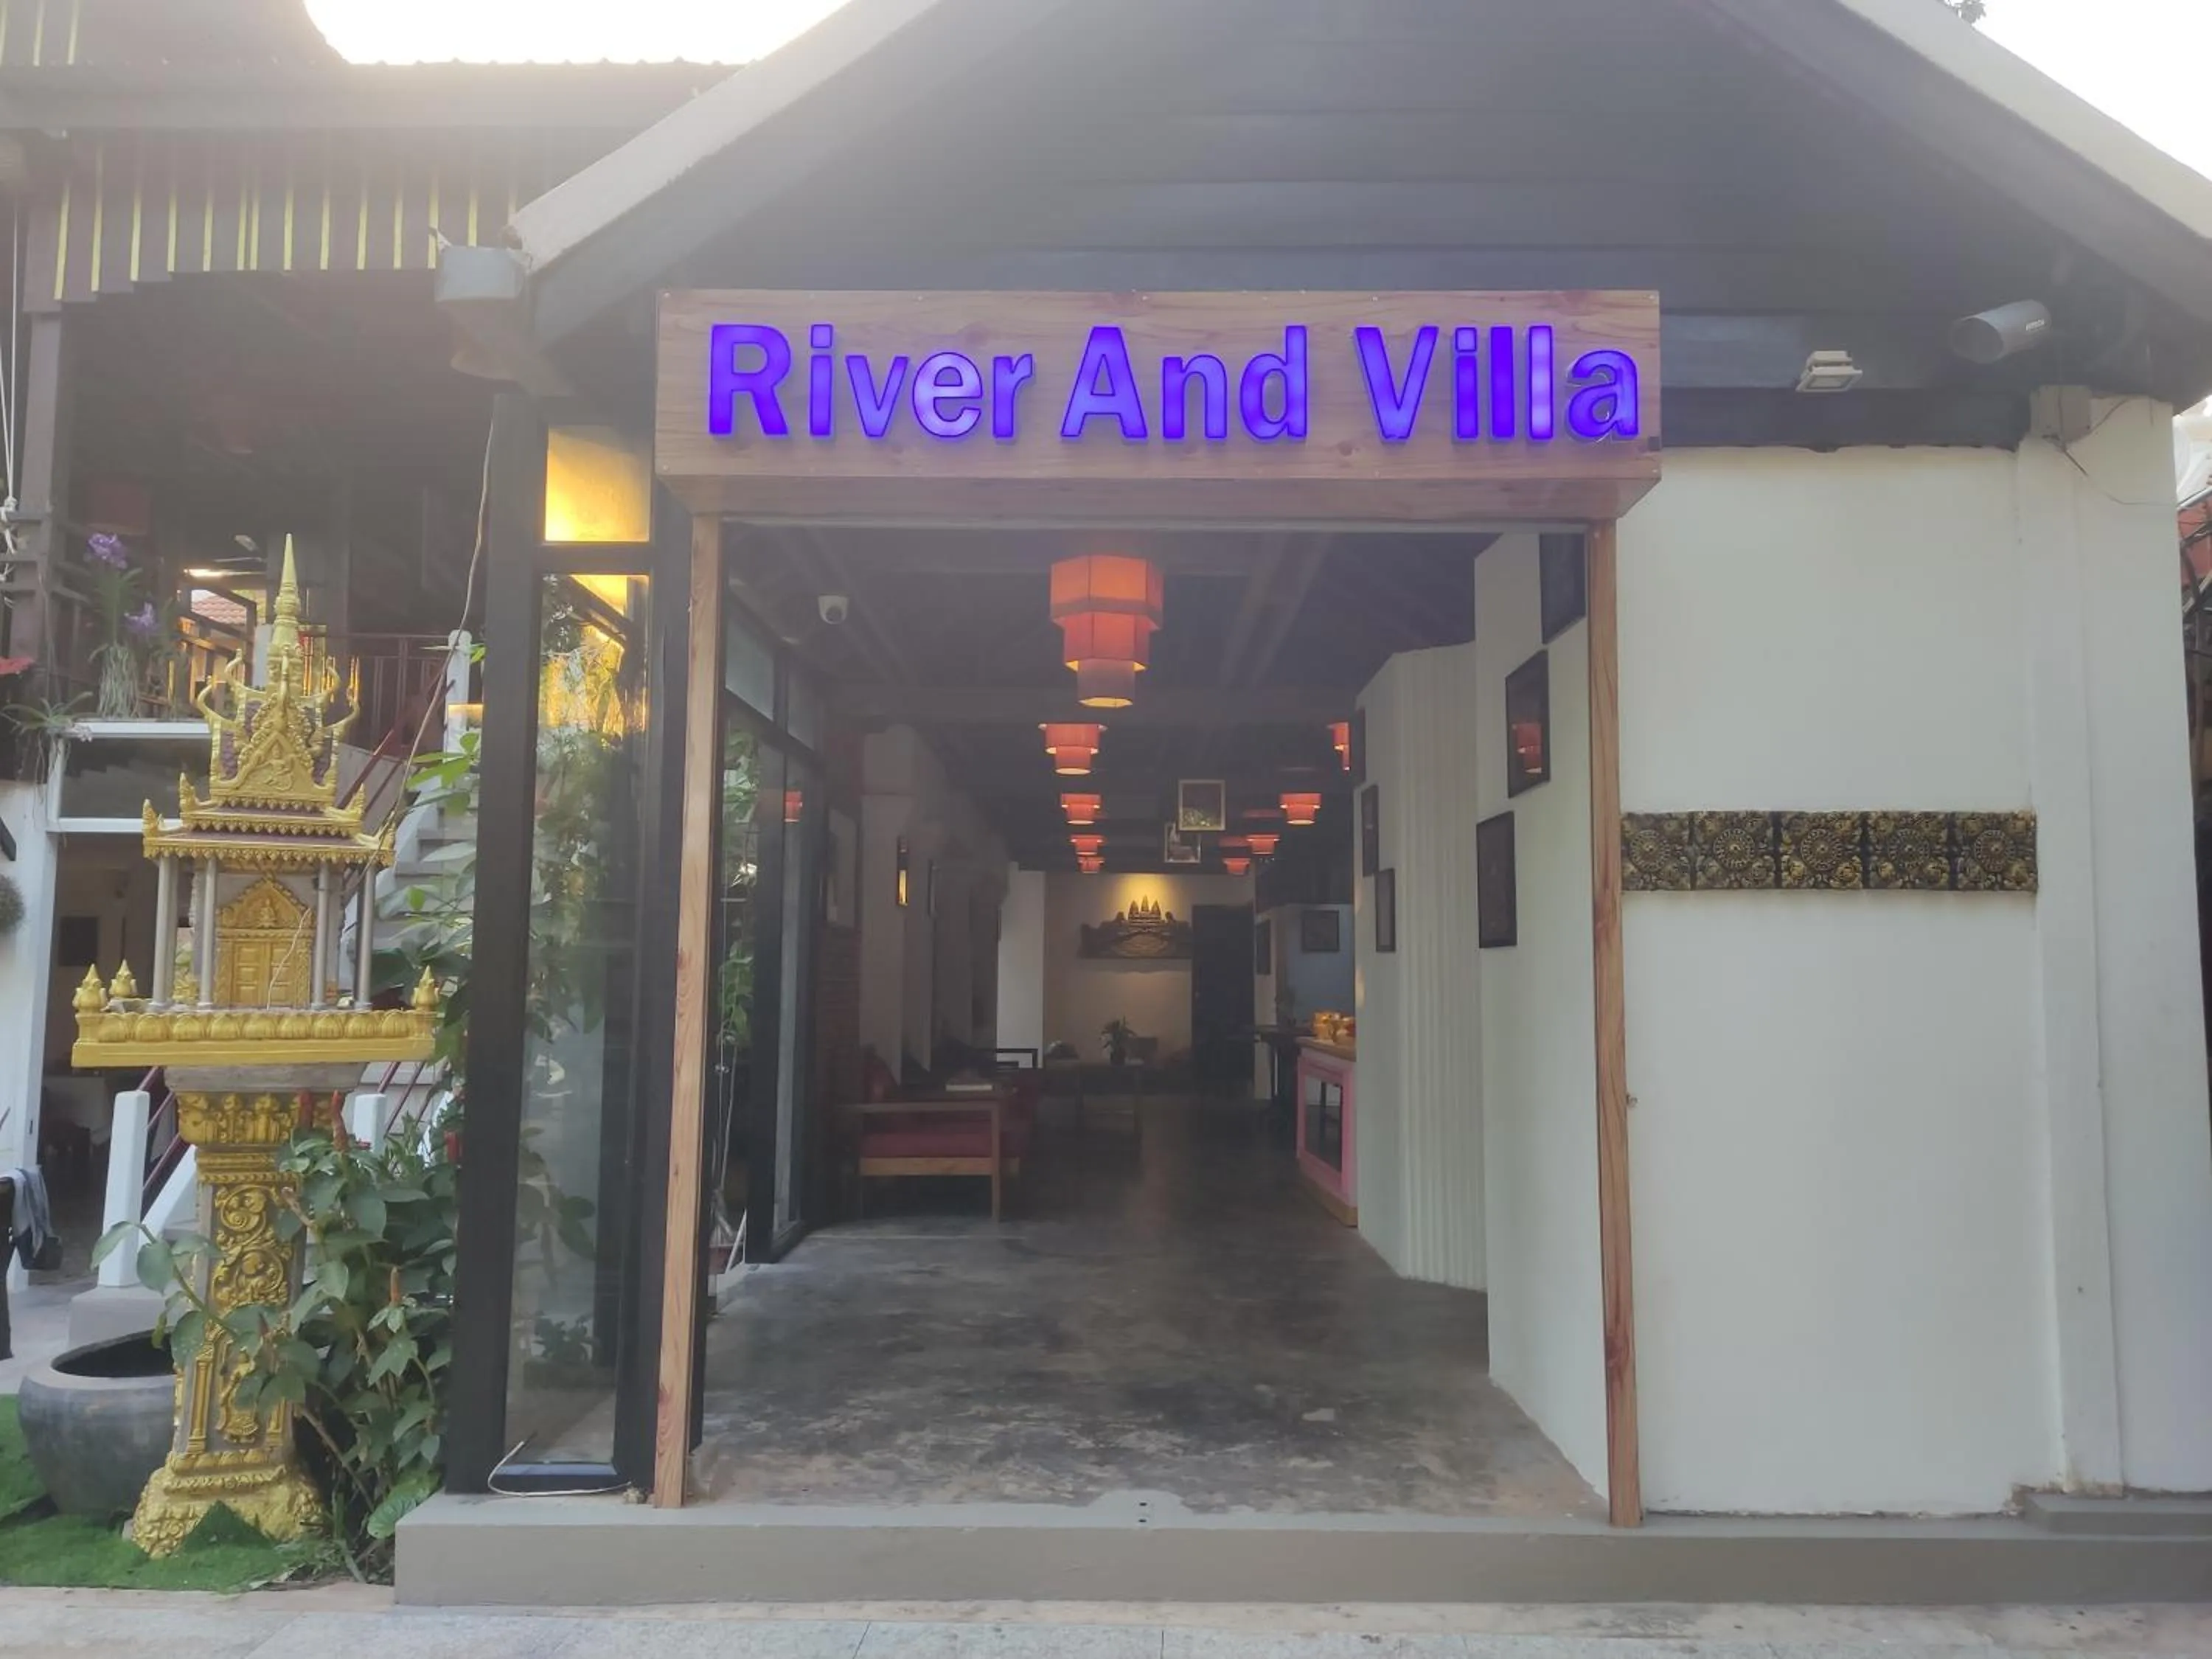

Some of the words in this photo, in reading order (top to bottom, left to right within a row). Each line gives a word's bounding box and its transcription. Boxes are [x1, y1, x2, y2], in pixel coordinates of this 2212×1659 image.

[709, 324, 1034, 438] River
[1060, 325, 1308, 439] And
[1354, 324, 1639, 439] Villa
